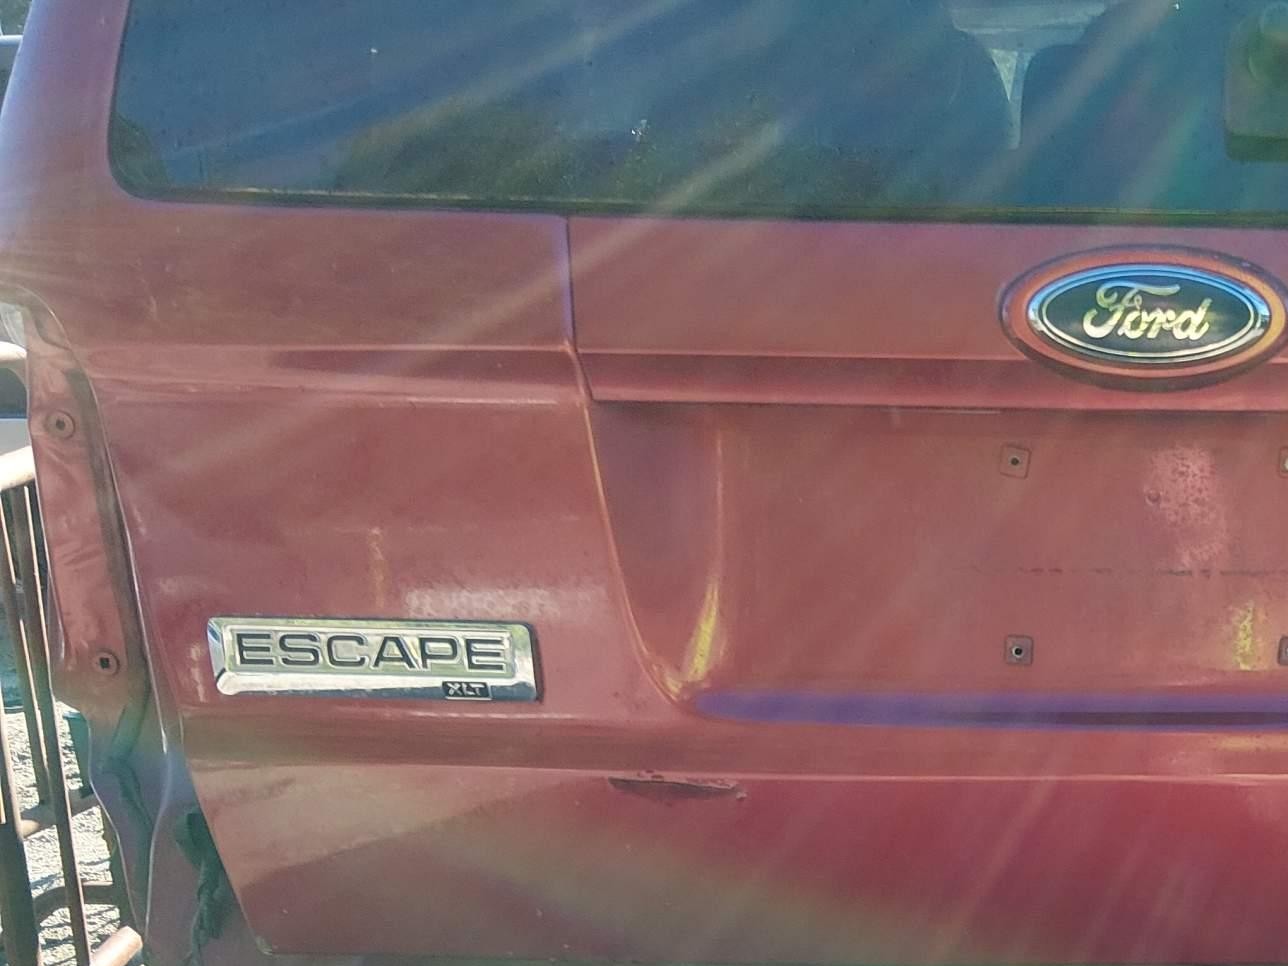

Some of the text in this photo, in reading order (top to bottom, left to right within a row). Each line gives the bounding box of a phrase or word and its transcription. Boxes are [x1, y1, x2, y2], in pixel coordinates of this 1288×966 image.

[1083, 280, 1213, 341] Ford
[235, 632, 507, 672] ESCAPE
[446, 682, 485, 697] XLT
